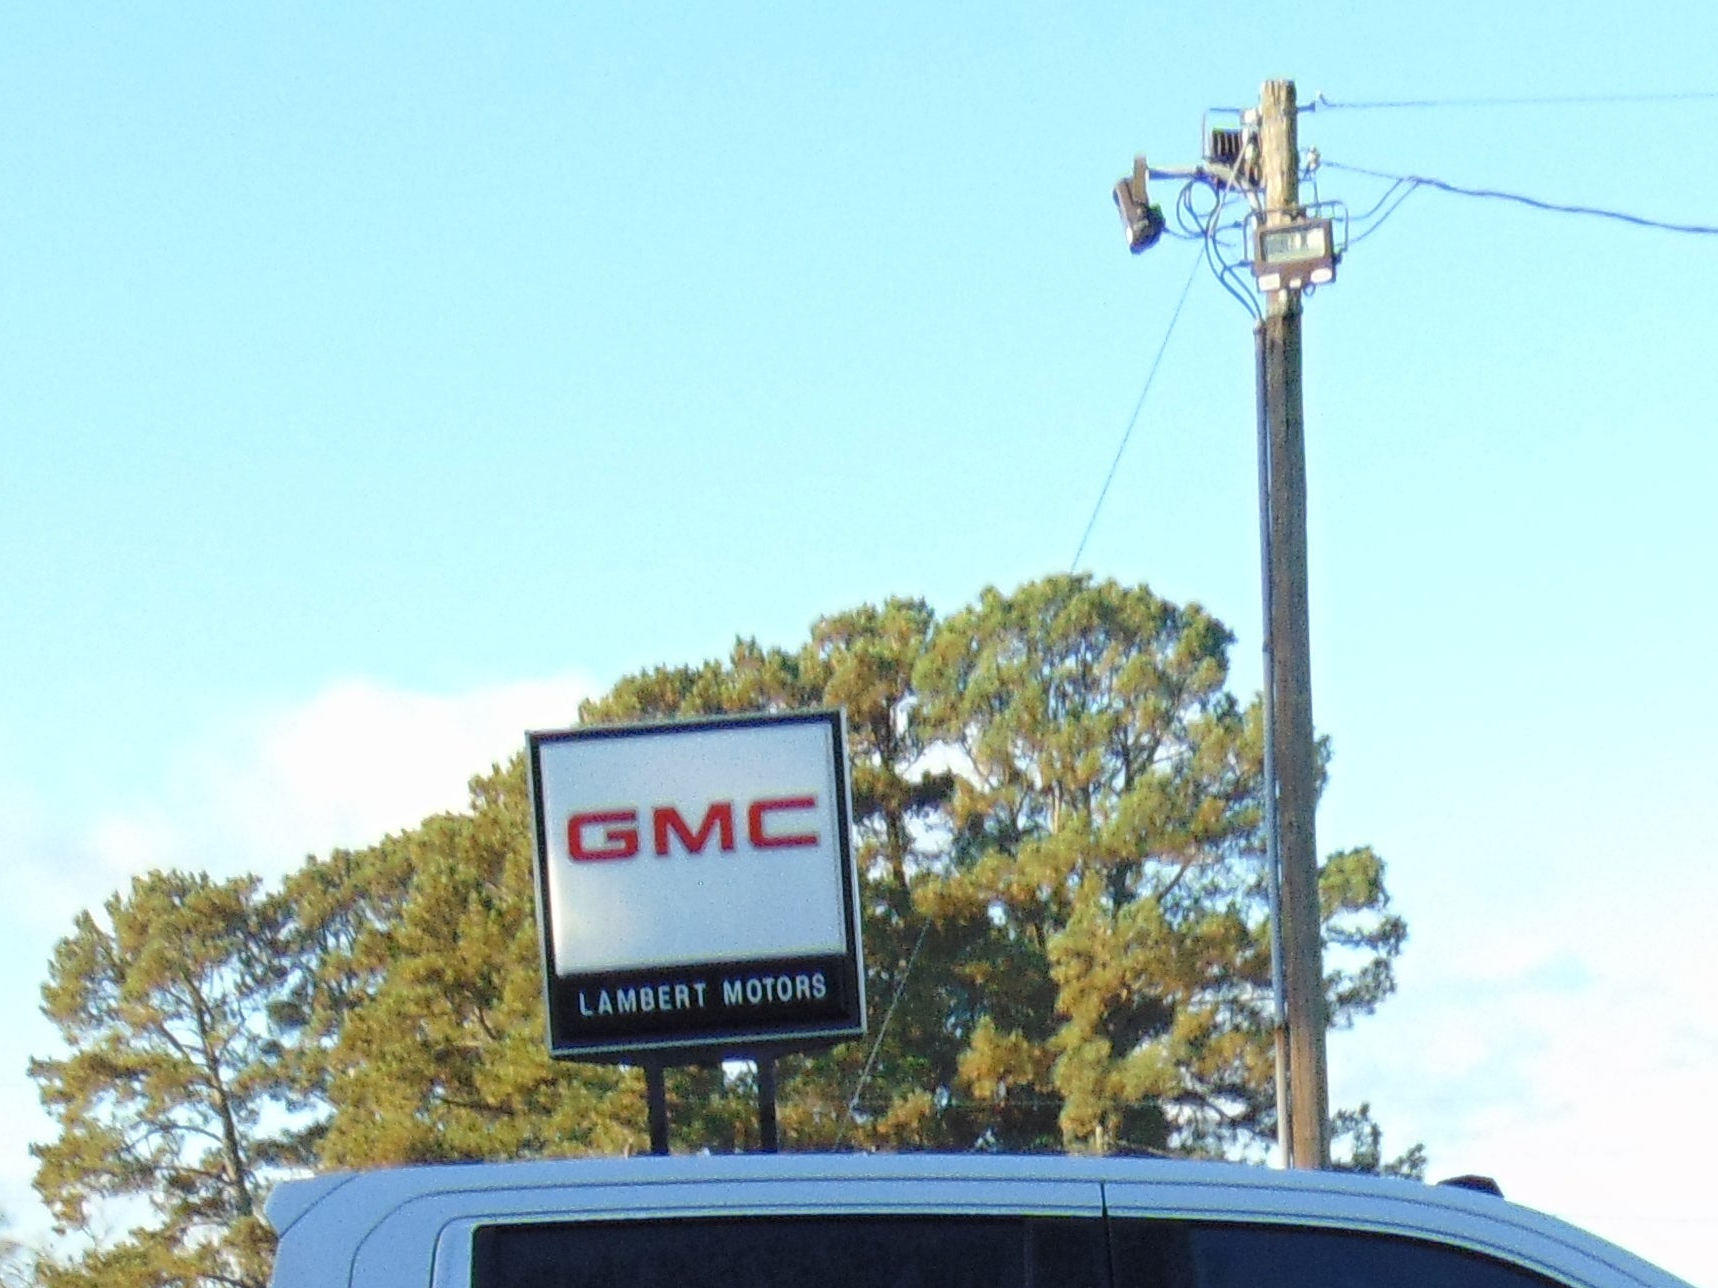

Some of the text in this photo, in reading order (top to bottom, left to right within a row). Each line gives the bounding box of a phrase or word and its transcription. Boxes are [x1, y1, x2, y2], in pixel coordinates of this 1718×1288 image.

[567, 797, 818, 862] GMC
[578, 971, 828, 1018] LAMBERT MOTORS
